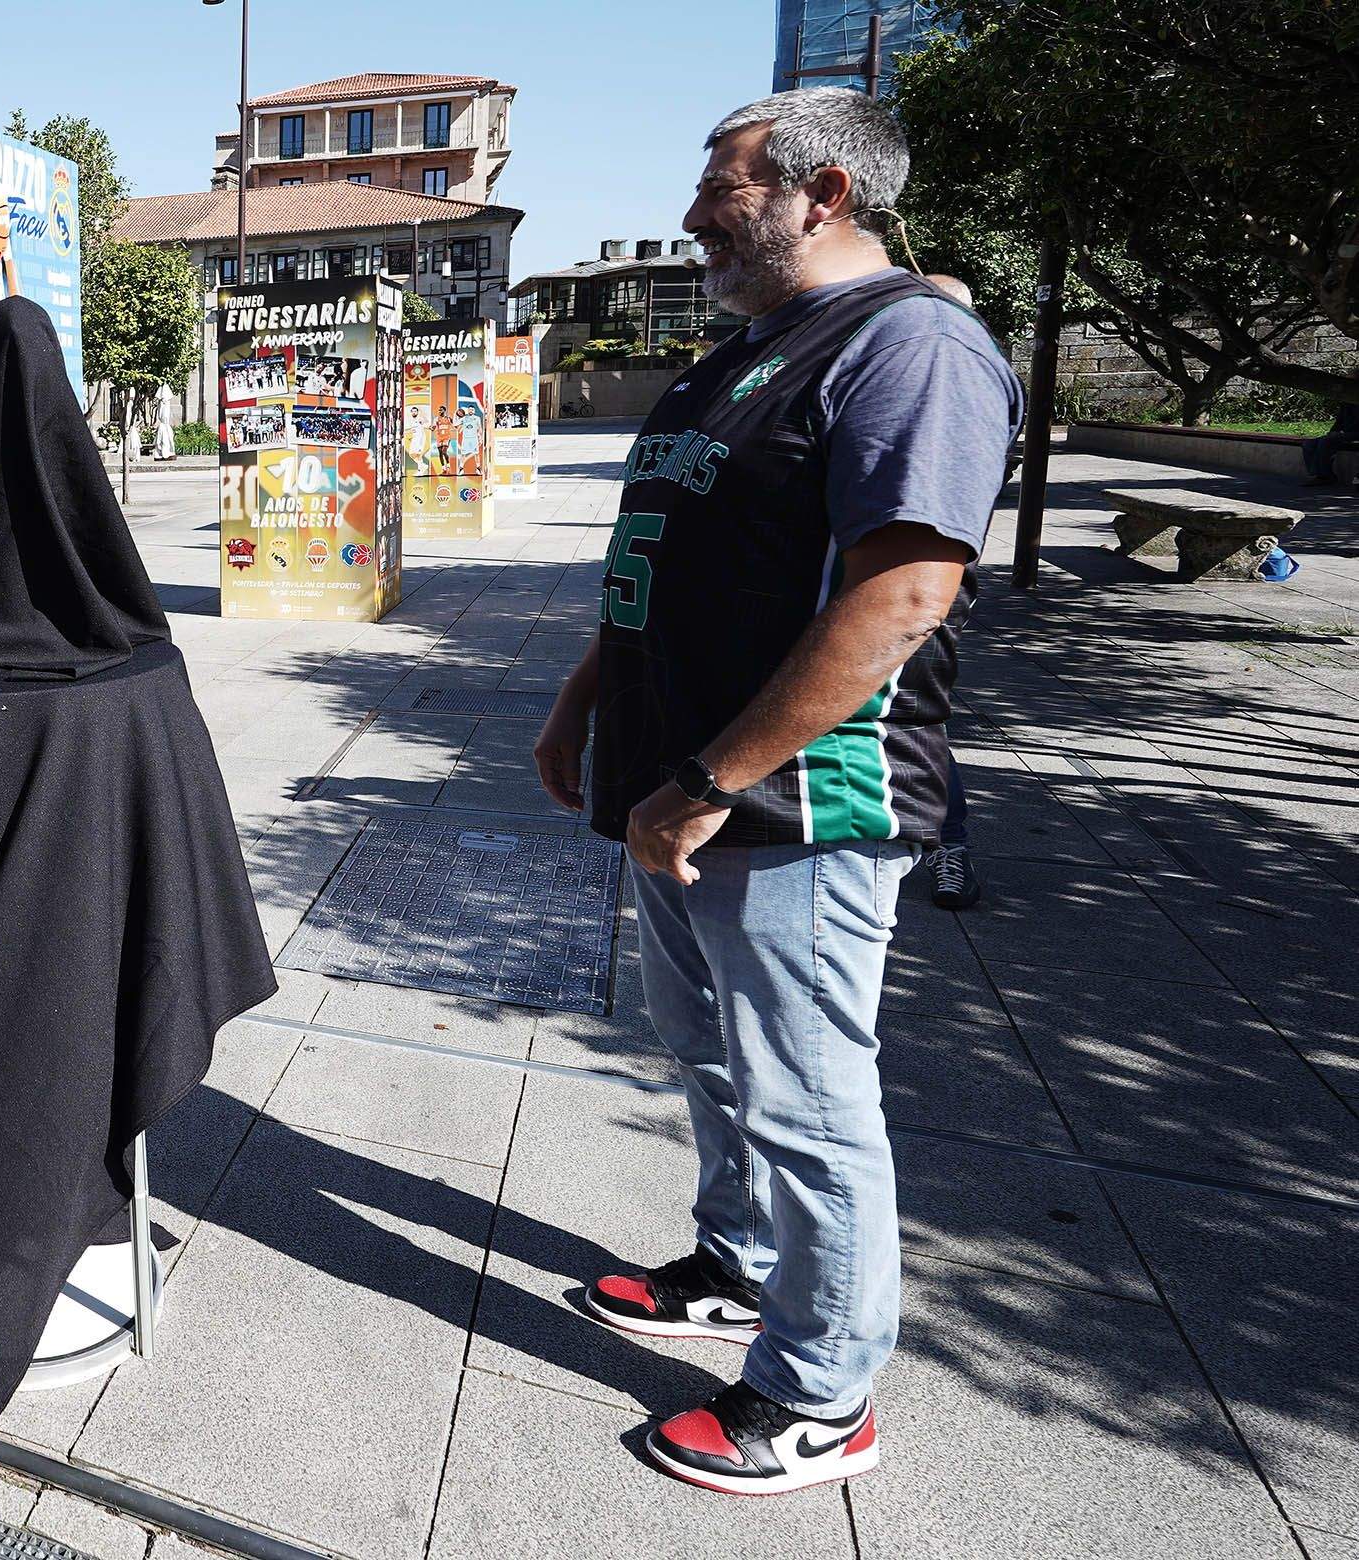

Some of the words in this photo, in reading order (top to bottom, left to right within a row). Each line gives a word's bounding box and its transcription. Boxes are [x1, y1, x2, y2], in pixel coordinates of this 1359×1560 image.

[7, 197, 48, 239] Facu
[224, 295, 265, 309] TORNEO
[225, 296, 373, 332] ENCESTARÍAS
[251, 336, 261, 349] X
[263, 331, 345, 347] ANIVERSARIO
[403, 330, 483, 352] CESTARÍAS
[405, 352, 468, 365] ANIVERSARIO
[267, 455, 324, 496] 10
[264, 497, 304, 512] ANOS
[310, 497, 330, 512] DE
[250, 513, 344, 528] BALONCESTO
